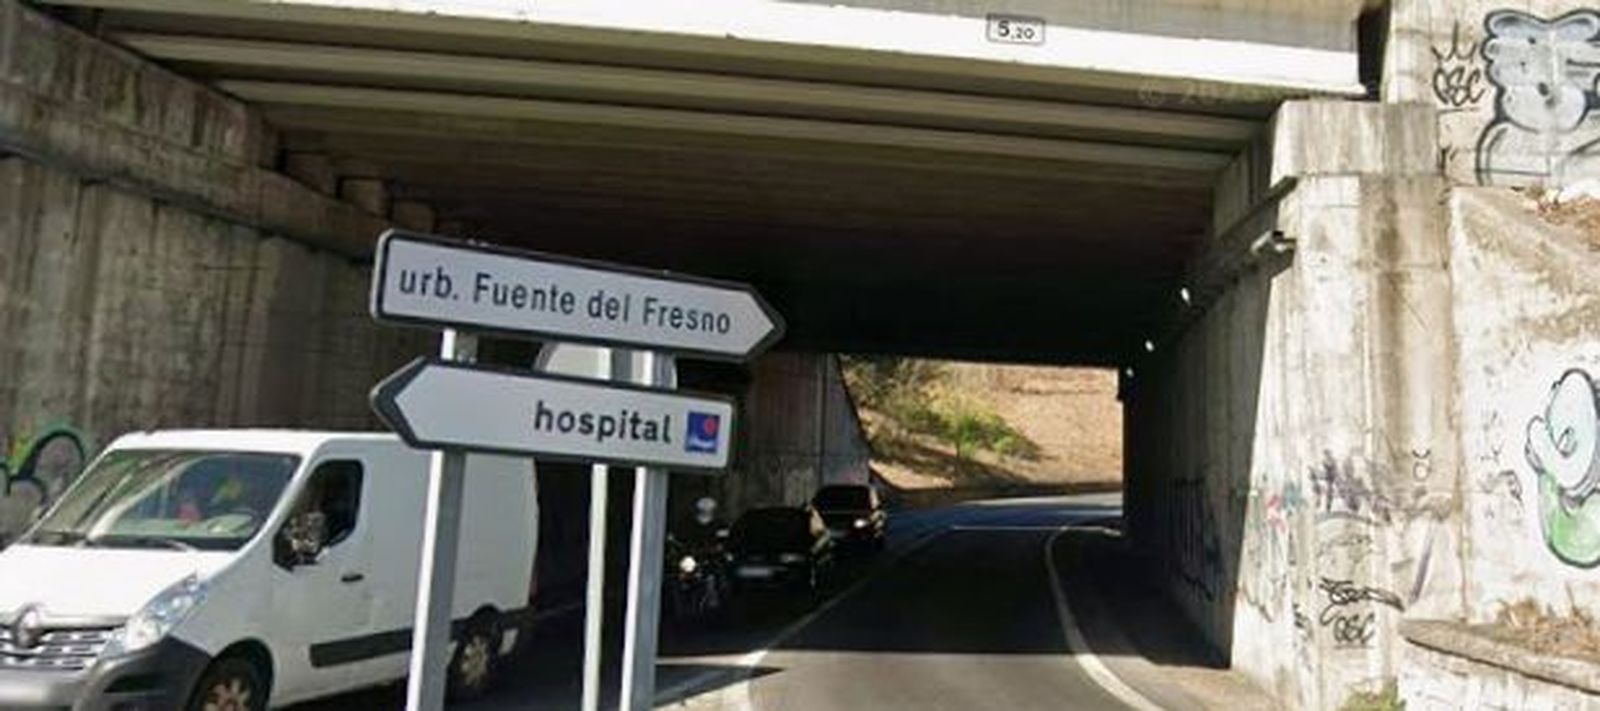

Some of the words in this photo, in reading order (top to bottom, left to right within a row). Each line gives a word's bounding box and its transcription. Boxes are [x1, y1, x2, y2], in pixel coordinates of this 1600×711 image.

[398, 265, 460, 304] urb.
[473, 272, 576, 316] Fuente
[587, 293, 632, 325] del
[642, 297, 731, 336] Fresno
[534, 401, 672, 445] hospital
